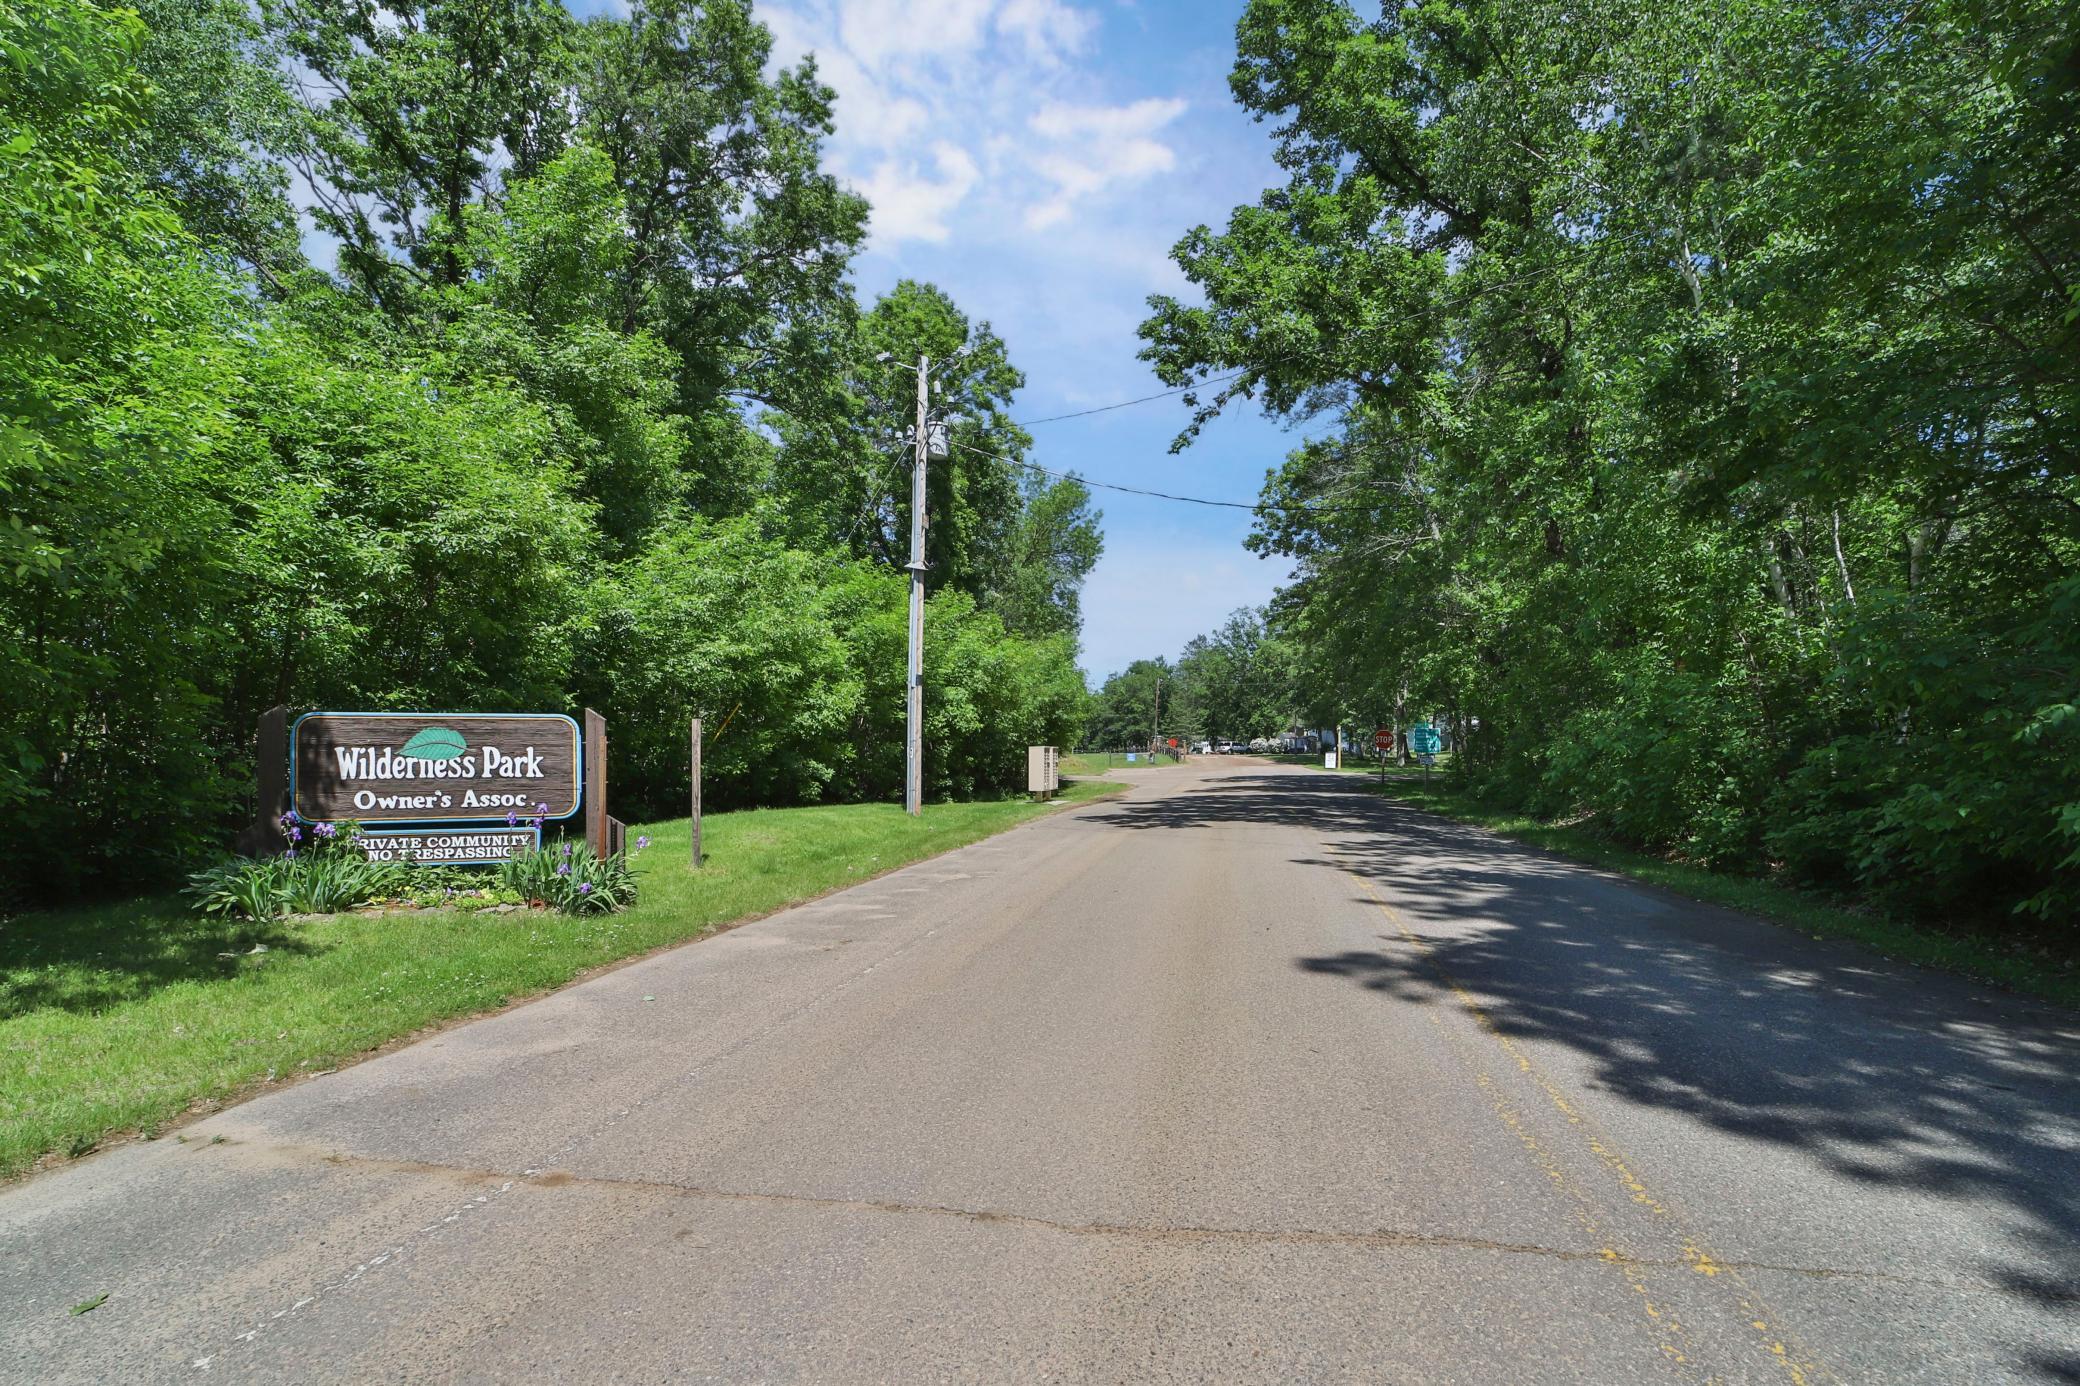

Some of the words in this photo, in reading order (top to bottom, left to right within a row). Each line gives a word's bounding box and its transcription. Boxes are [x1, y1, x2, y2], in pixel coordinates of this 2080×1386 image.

[334, 746, 476, 780] Wilderness
[481, 746, 545, 778] Park
[353, 789, 452, 809] Owner's
[357, 837, 422, 850] RIVATE
[426, 834, 531, 848] COMMUNITY
[368, 849, 393, 861] NO
